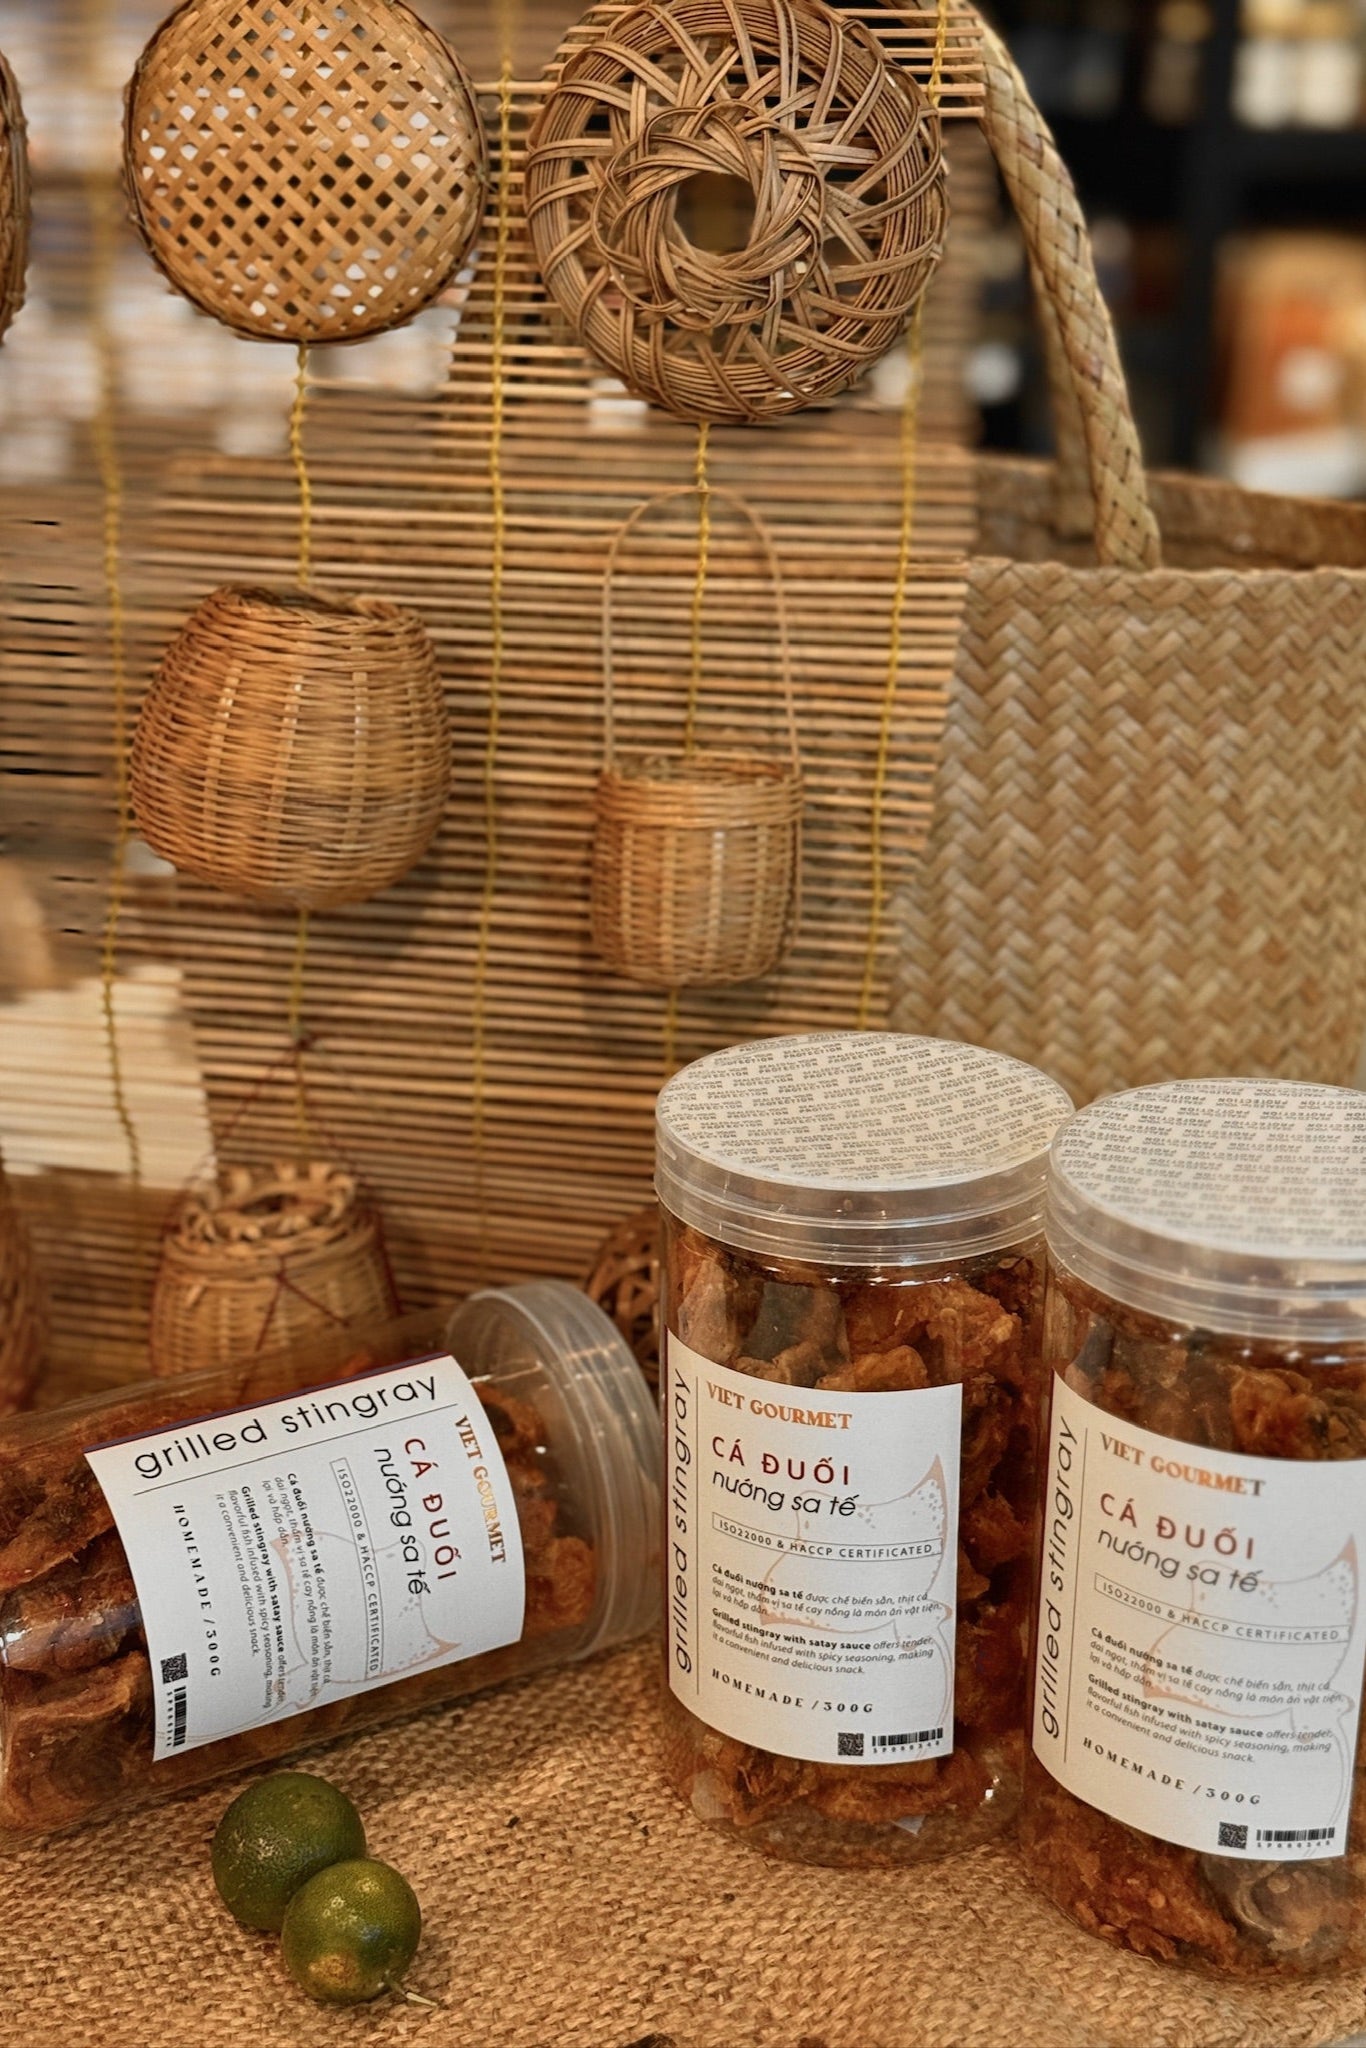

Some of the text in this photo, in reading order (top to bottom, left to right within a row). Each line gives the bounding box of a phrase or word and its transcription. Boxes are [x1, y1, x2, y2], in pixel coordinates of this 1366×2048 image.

[134, 1376, 435, 1479] grilled stingray
[706, 1381, 853, 1429] VIET GOURMET
[672, 1368, 691, 1534] stingray
[712, 1436, 849, 1485] CÁ ĐUỐI
[1100, 1432, 1266, 1496] VIET GOURMET
[404, 1438, 462, 1580] CÁ ĐUỐI
[455, 1415, 506, 1563] VIET GOURMET
[712, 1471, 860, 1516] nướng sa tế
[1048, 1415, 1078, 1591] stingray
[220, 1509, 244, 1561] convenient
[373, 1448, 431, 1594] nướng sa tế
[719, 1519, 933, 1558] ISO22000 & HACCP CERTIFICATED
[1100, 1493, 1253, 1560] CÁ ĐUỐI
[172, 1504, 212, 1609] HOMEMADE
[236, 1562, 250, 1582] and
[241, 1486, 285, 1652] Grilled stingray with satay sauce
[337, 1468, 380, 1671] ISO22000 & HACCP CERTIFICATED
[1098, 1529, 1263, 1593] nướng sa tế
[241, 1584, 256, 1626] delicious
[672, 1541, 692, 1674] grilled
[779, 1589, 790, 1597] sa
[1103, 1582, 1340, 1641] ISO22000 & HACCP CERTIFICATED
[712, 1607, 740, 1627] Grilled
[742, 1622, 781, 1641] stingray
[783, 1632, 806, 1645] with
[808, 1638, 837, 1650] satay
[840, 1641, 871, 1650] sauce
[725, 1637, 770, 1661] convenient
[771, 1656, 790, 1667] and
[791, 1658, 834, 1674] delicious
[744, 1633, 759, 1646] fish
[760, 1640, 793, 1654] infused
[795, 1648, 816, 1659] with
[818, 1650, 846, 1663] spicy
[898, 1649, 934, 1660] making
[711, 1668, 804, 1708] HOMEMADE
[1040, 1598, 1062, 1740] grilled
[1088, 1673, 1120, 1697] Grilled
[1122, 1692, 1165, 1716] stingray
[1167, 1709, 1192, 1724] with
[1195, 1718, 1226, 1734] satay
[1229, 1727, 1263, 1738] sauce
[1082, 1736, 1186, 1790] HOMEMADE
[1152, 1731, 1172, 1744] and
[1173, 1738, 1219, 1758] delicious
[1204, 1733, 1231, 1748] spicy
